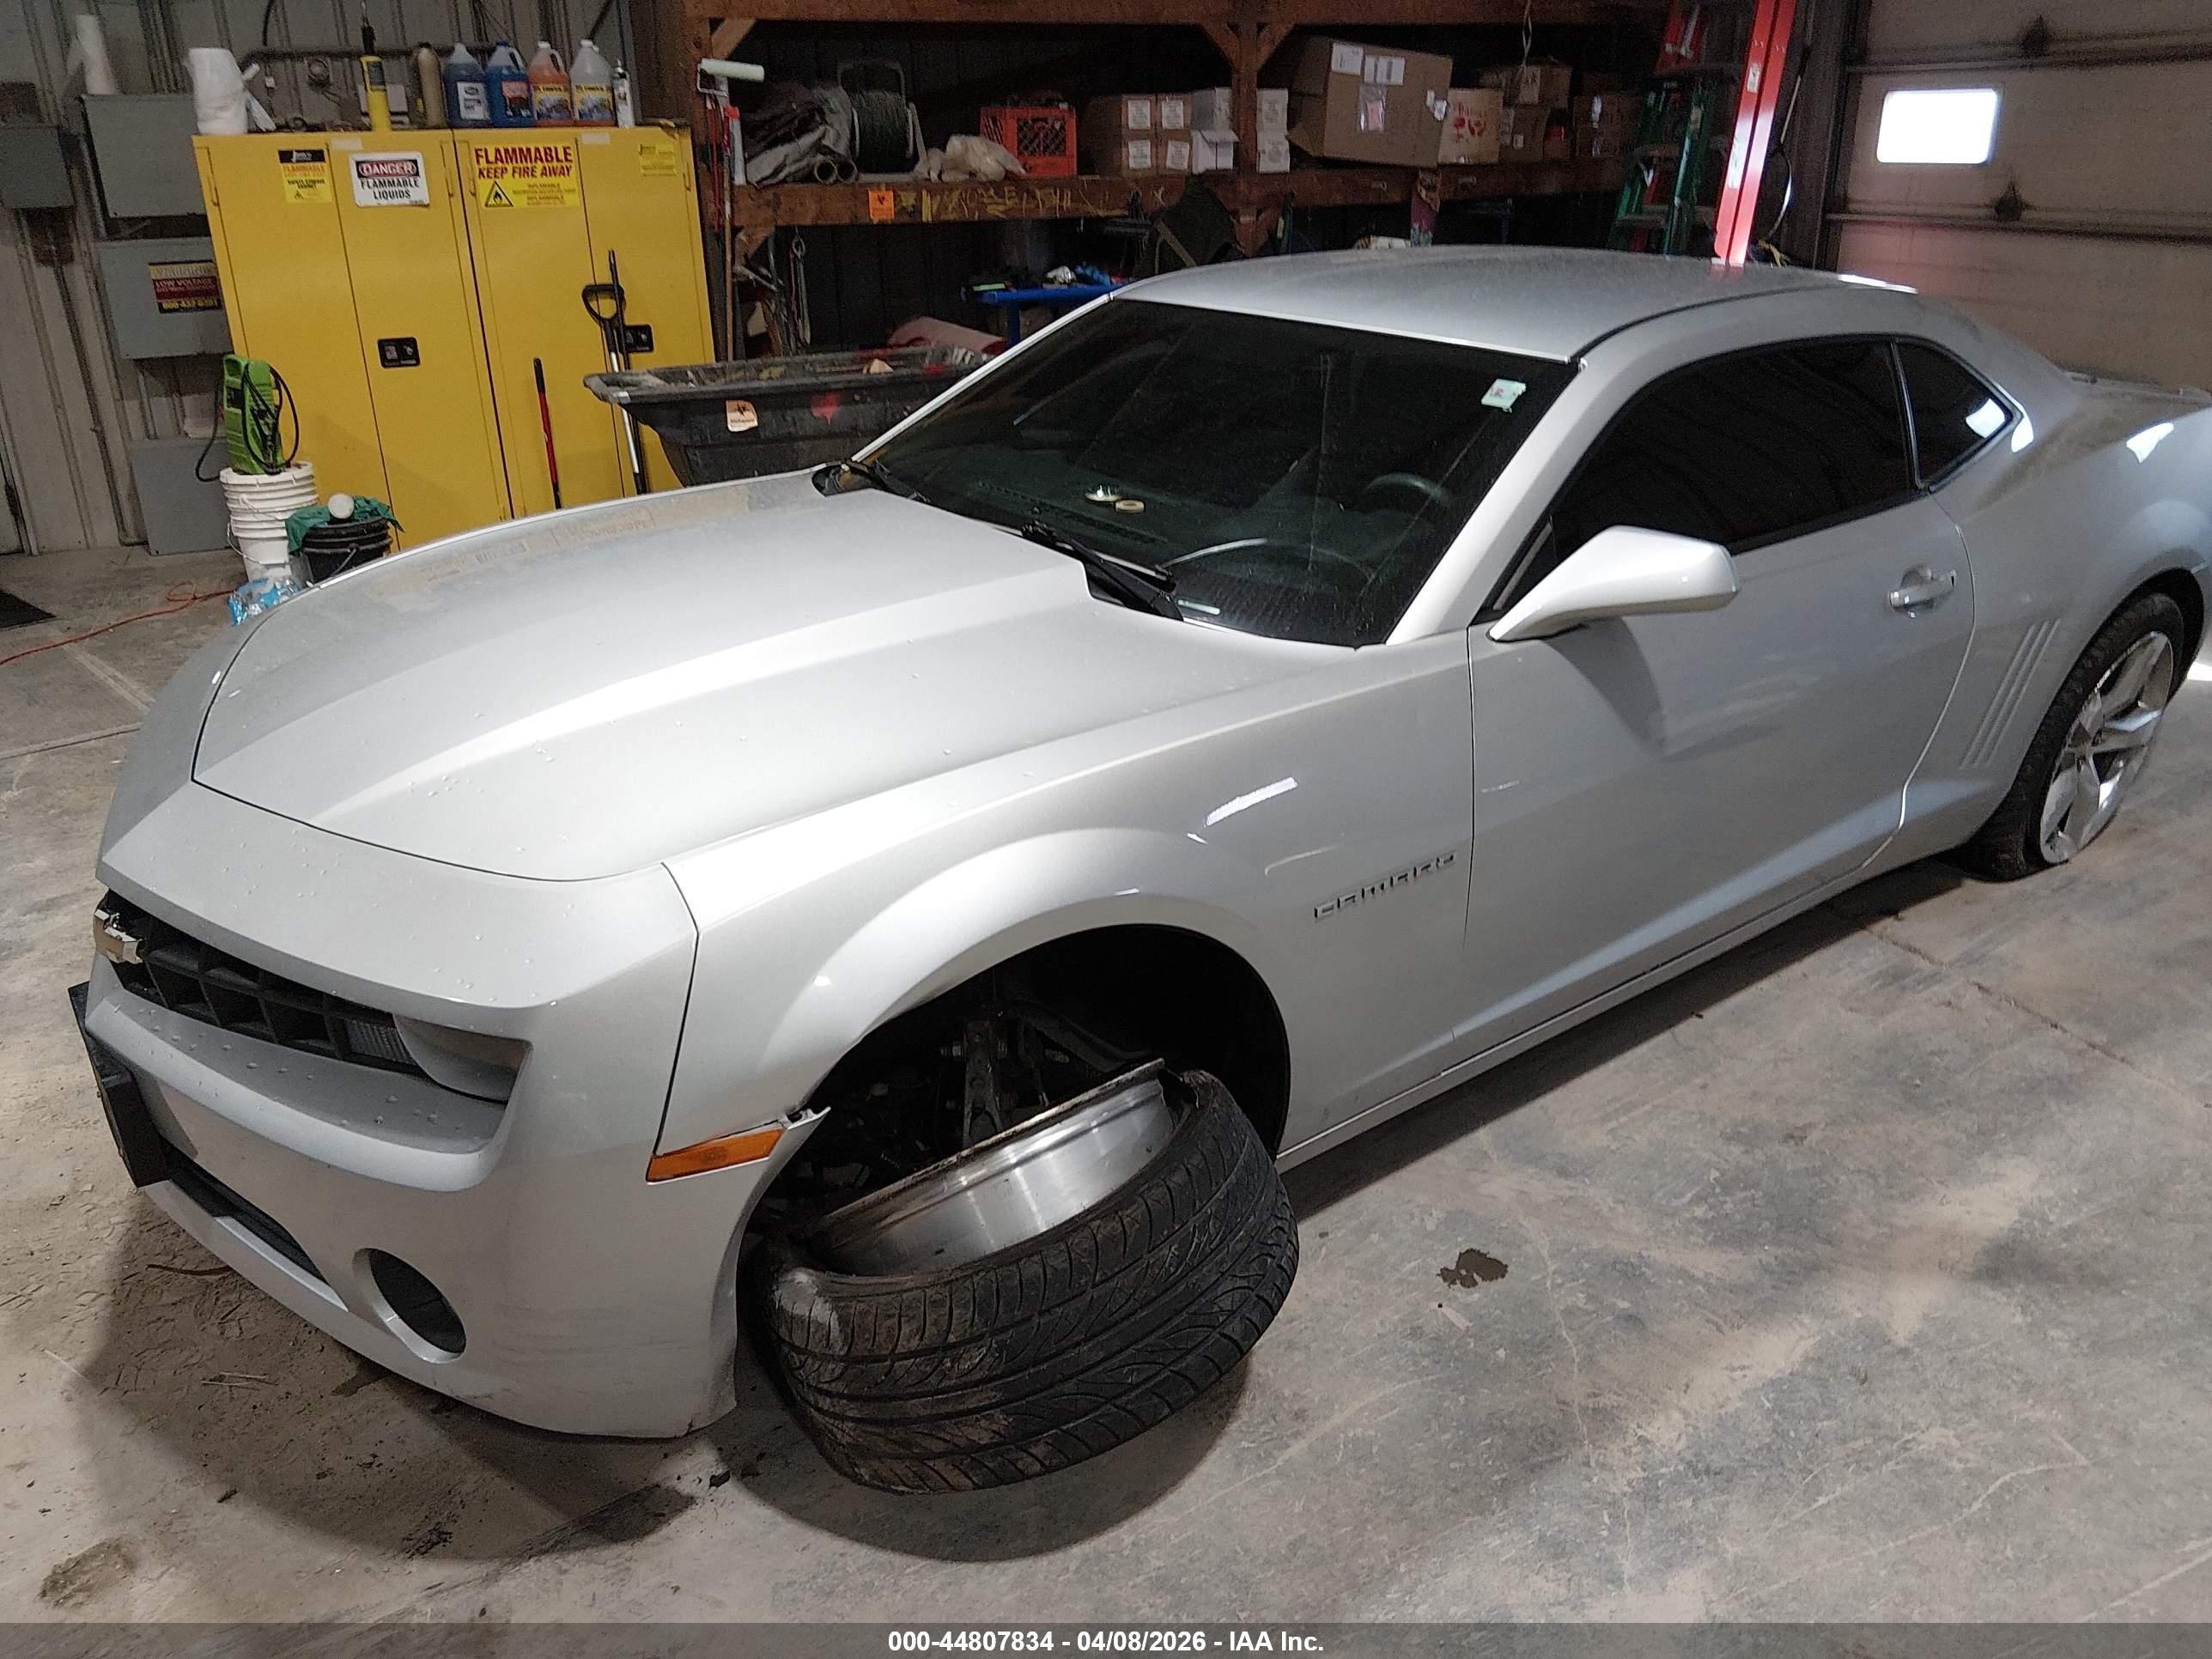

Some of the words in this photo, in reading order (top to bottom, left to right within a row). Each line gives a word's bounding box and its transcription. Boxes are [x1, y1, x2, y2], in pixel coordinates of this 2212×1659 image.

[473, 146, 573, 165] FLAMMABLE
[362, 161, 413, 175] DANGER
[478, 167, 508, 179] KEEP
[512, 166, 538, 179] FIRE
[540, 165, 572, 178] AWAY
[360, 178, 420, 190] FLAMMABLE
[374, 189, 411, 200] LIQUIDS
[1314, 854, 1455, 919] CAMARO
